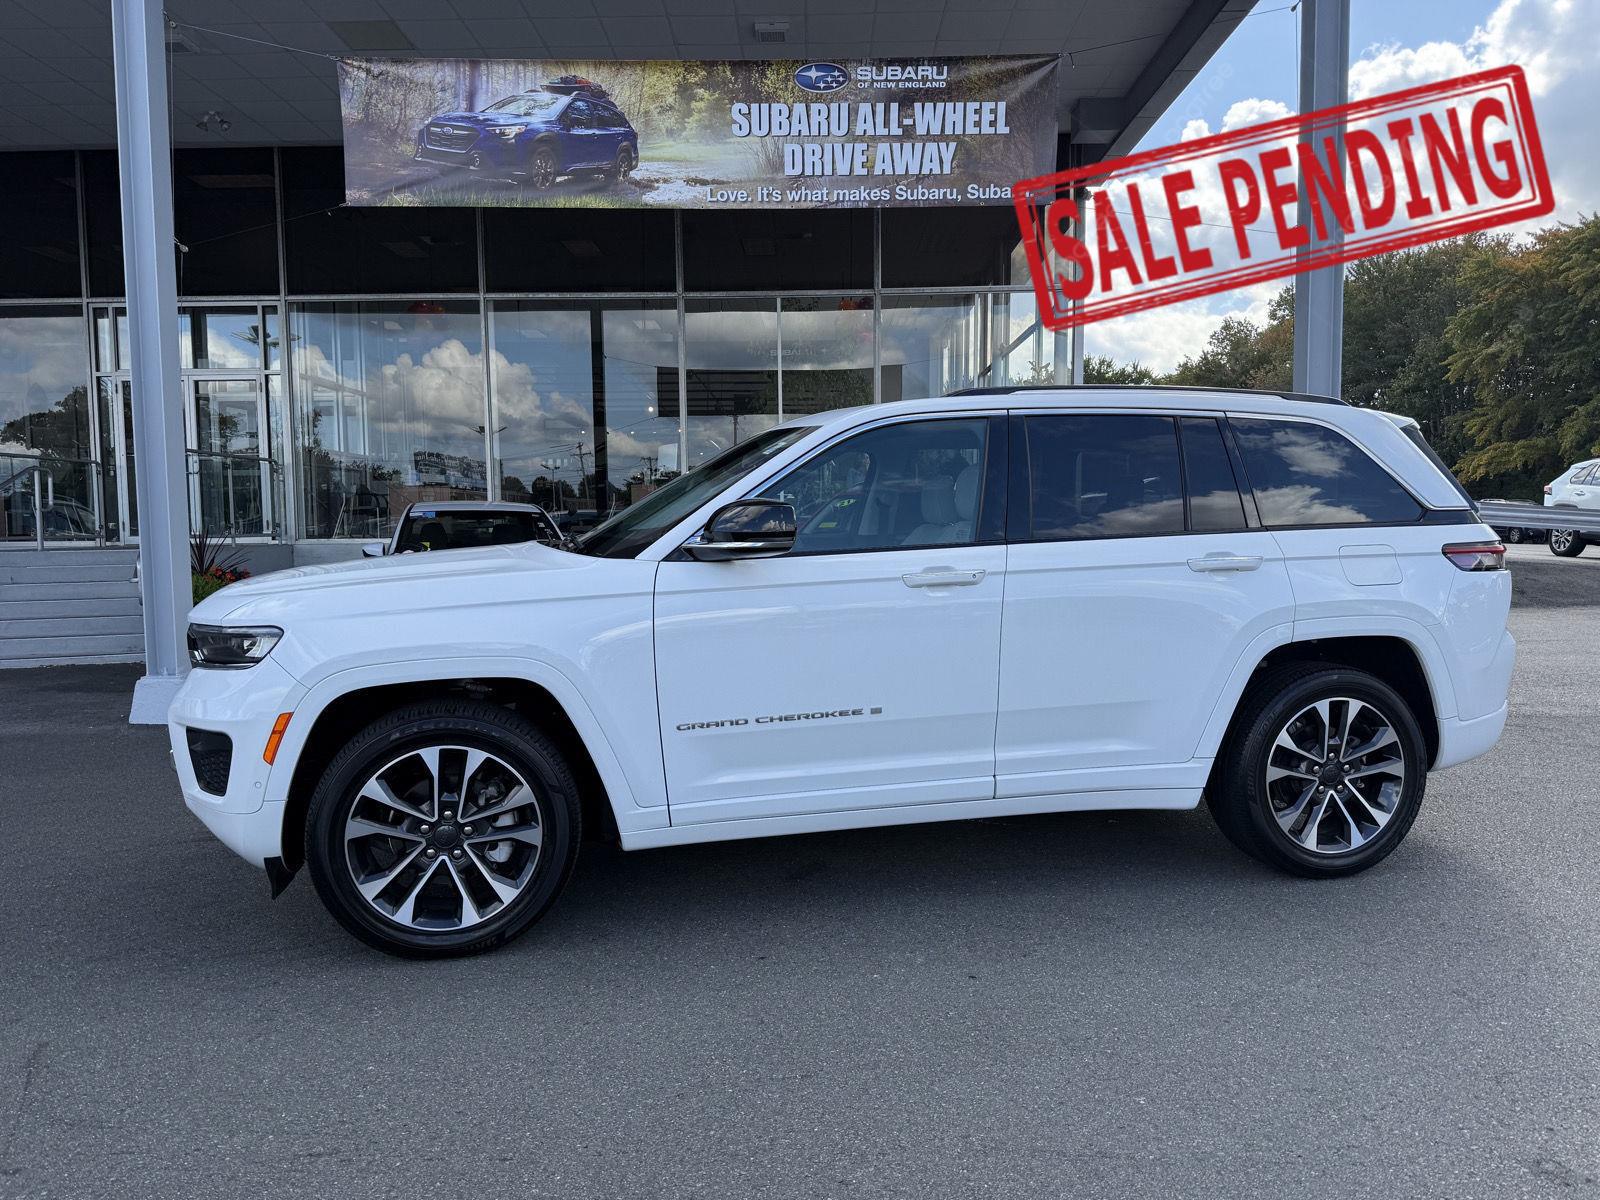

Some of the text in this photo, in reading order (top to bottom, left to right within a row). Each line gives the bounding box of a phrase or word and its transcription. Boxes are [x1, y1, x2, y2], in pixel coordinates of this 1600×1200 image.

[857, 66, 948, 80] SUBARU
[731, 101, 1010, 137] SUBARU ALL-WHEEL
[784, 142, 957, 176] DRIVE AWAY
[706, 187, 751, 202] Love.
[787, 186, 828, 201] what
[833, 185, 892, 201] makes
[895, 184, 962, 202] Subaru,
[676, 708, 864, 731] GRAND CHEROKEE
